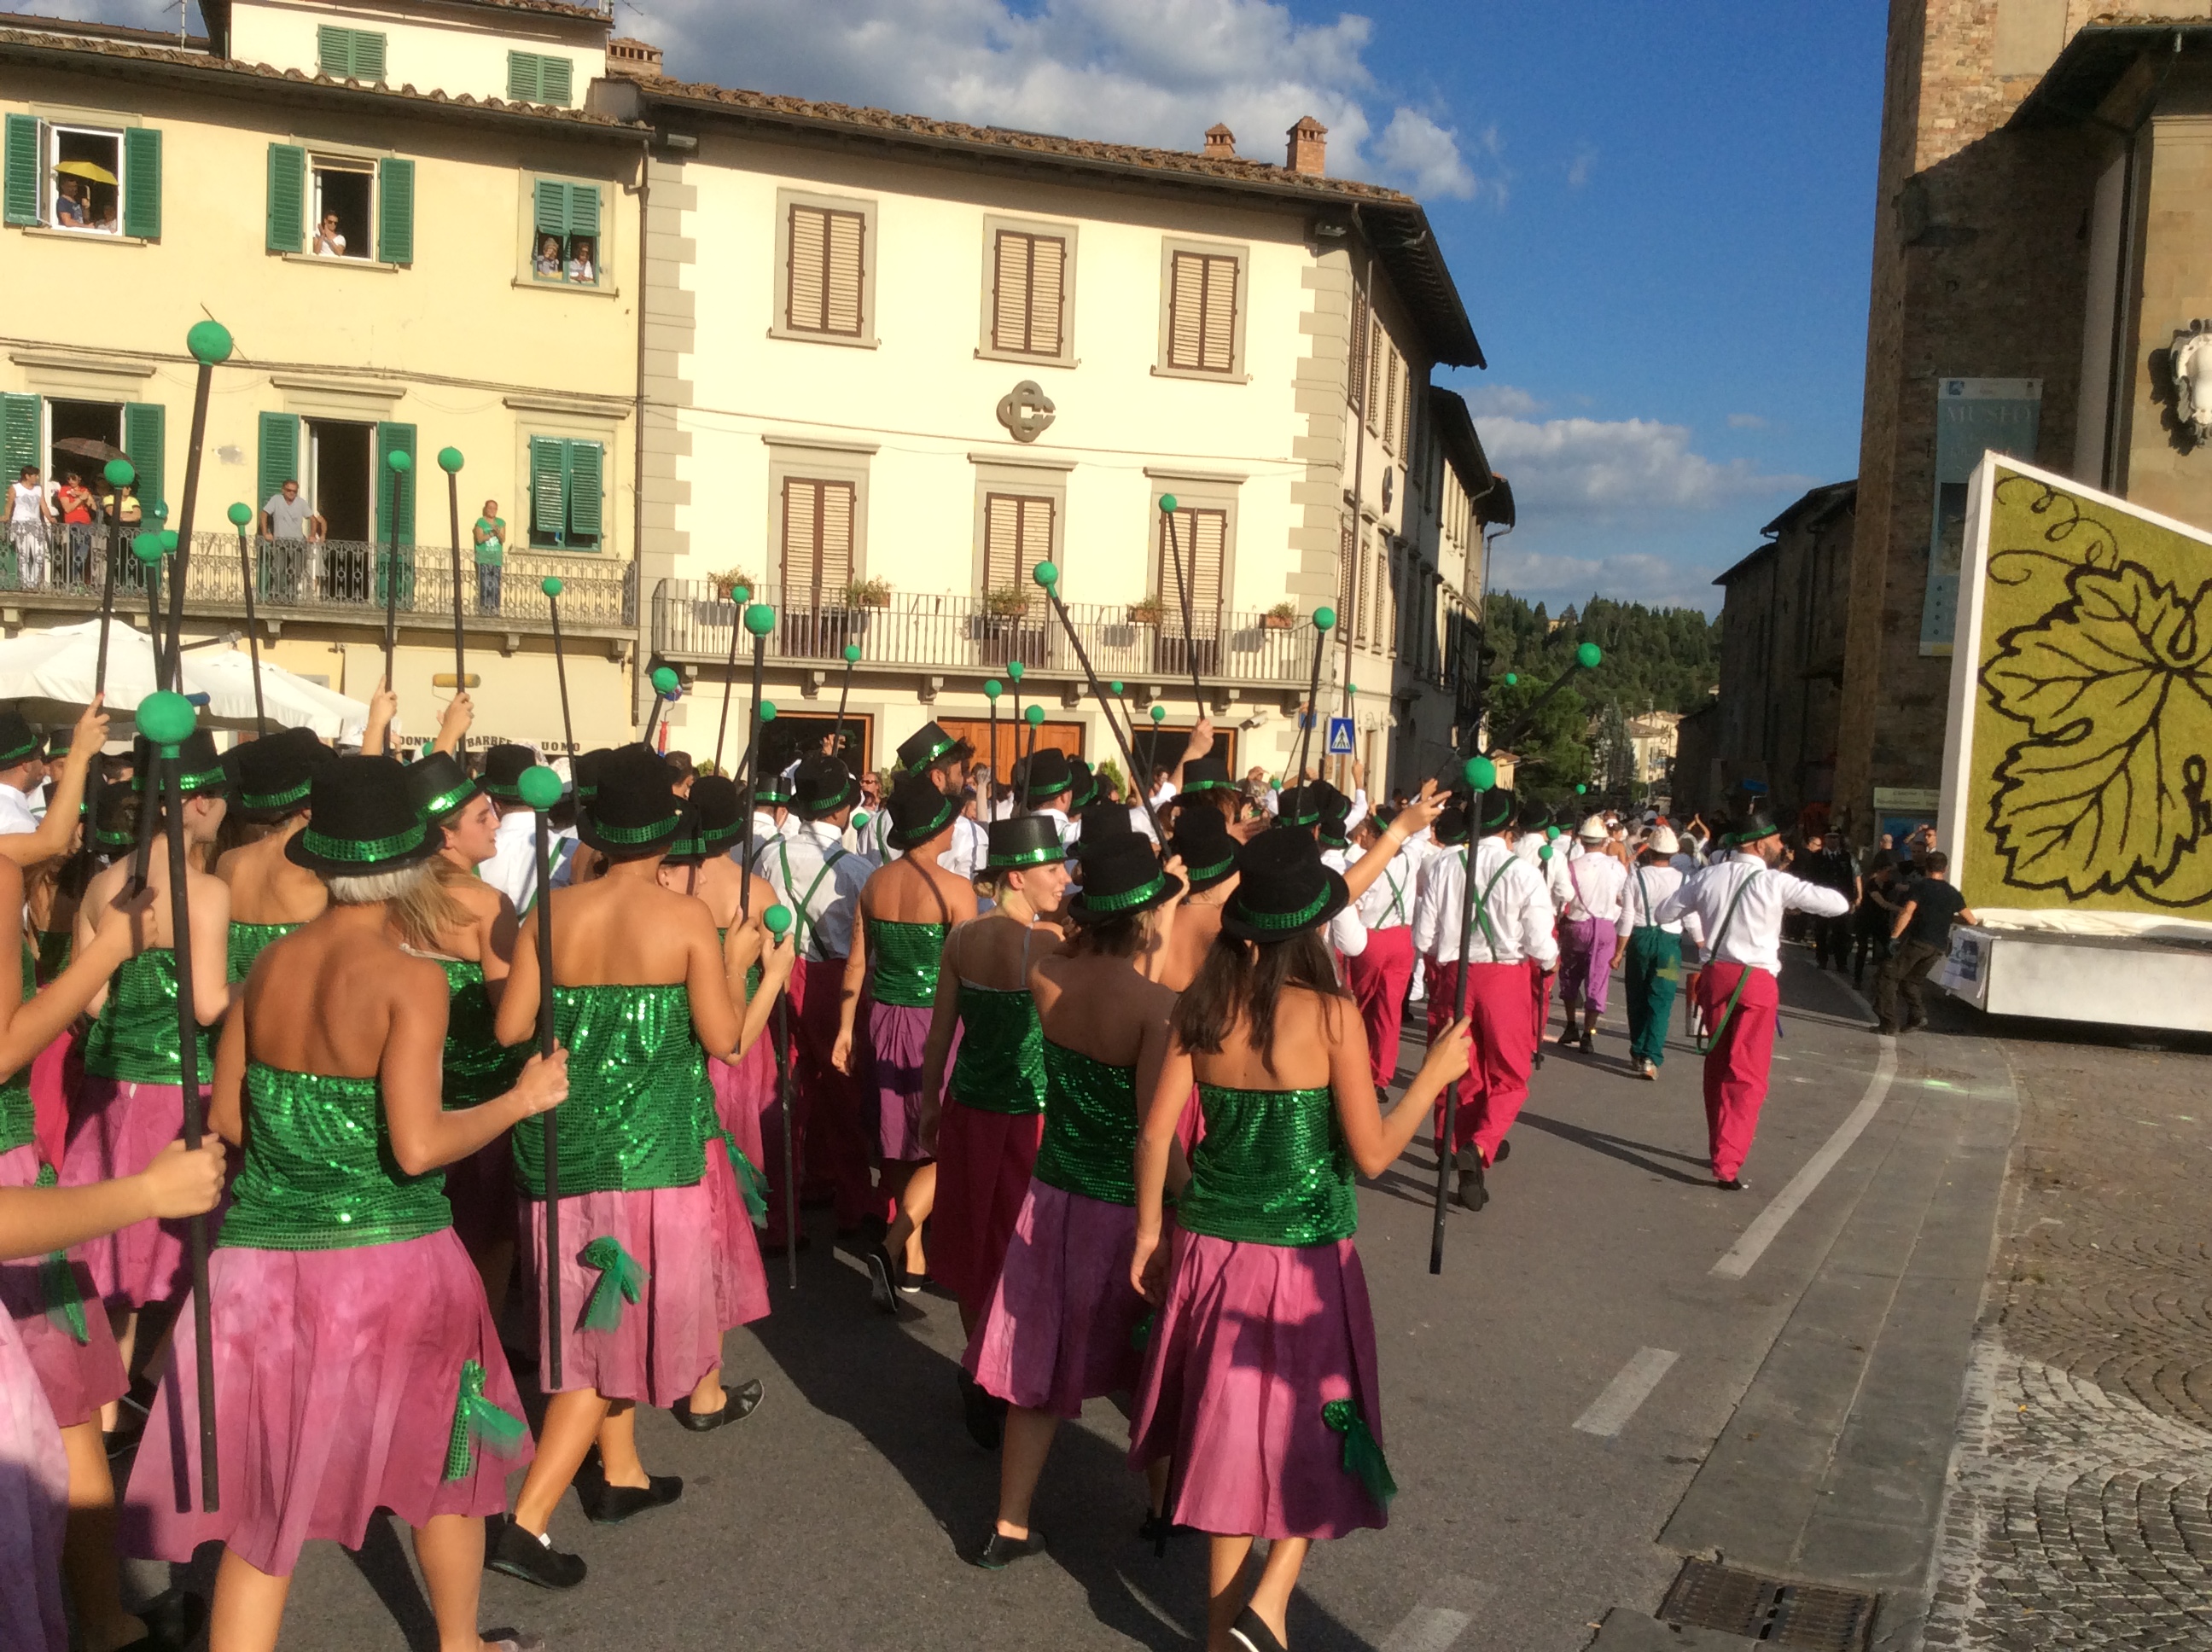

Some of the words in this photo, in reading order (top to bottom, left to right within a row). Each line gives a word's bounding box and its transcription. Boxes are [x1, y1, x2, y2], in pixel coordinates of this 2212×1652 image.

[1947, 405, 2032, 423] MUSEO
[399, 736, 438, 747] DONN
[541, 742, 580, 752] UOMO
